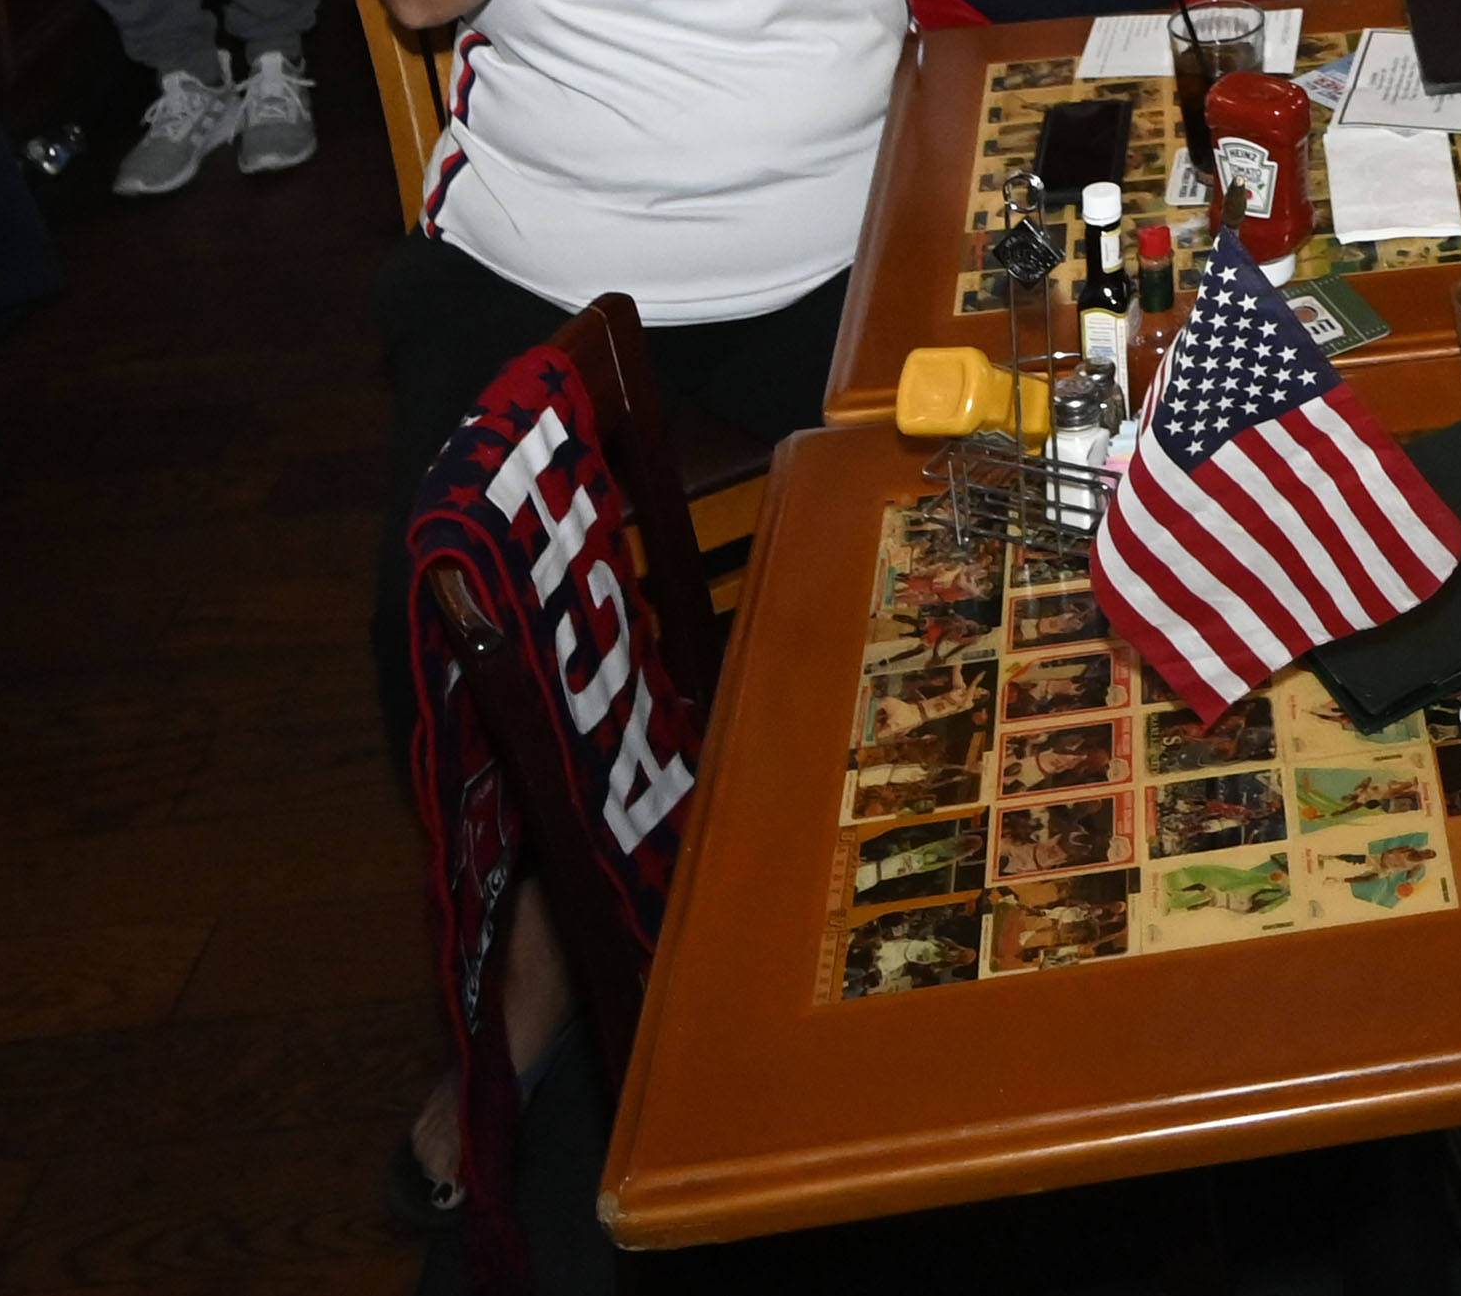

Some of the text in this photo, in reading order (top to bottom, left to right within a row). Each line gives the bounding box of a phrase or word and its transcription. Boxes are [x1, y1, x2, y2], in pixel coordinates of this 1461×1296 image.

[1229, 149, 1258, 162] HEINZ
[1230, 163, 1262, 178] TOMATO
[484, 405, 695, 855] ACH
